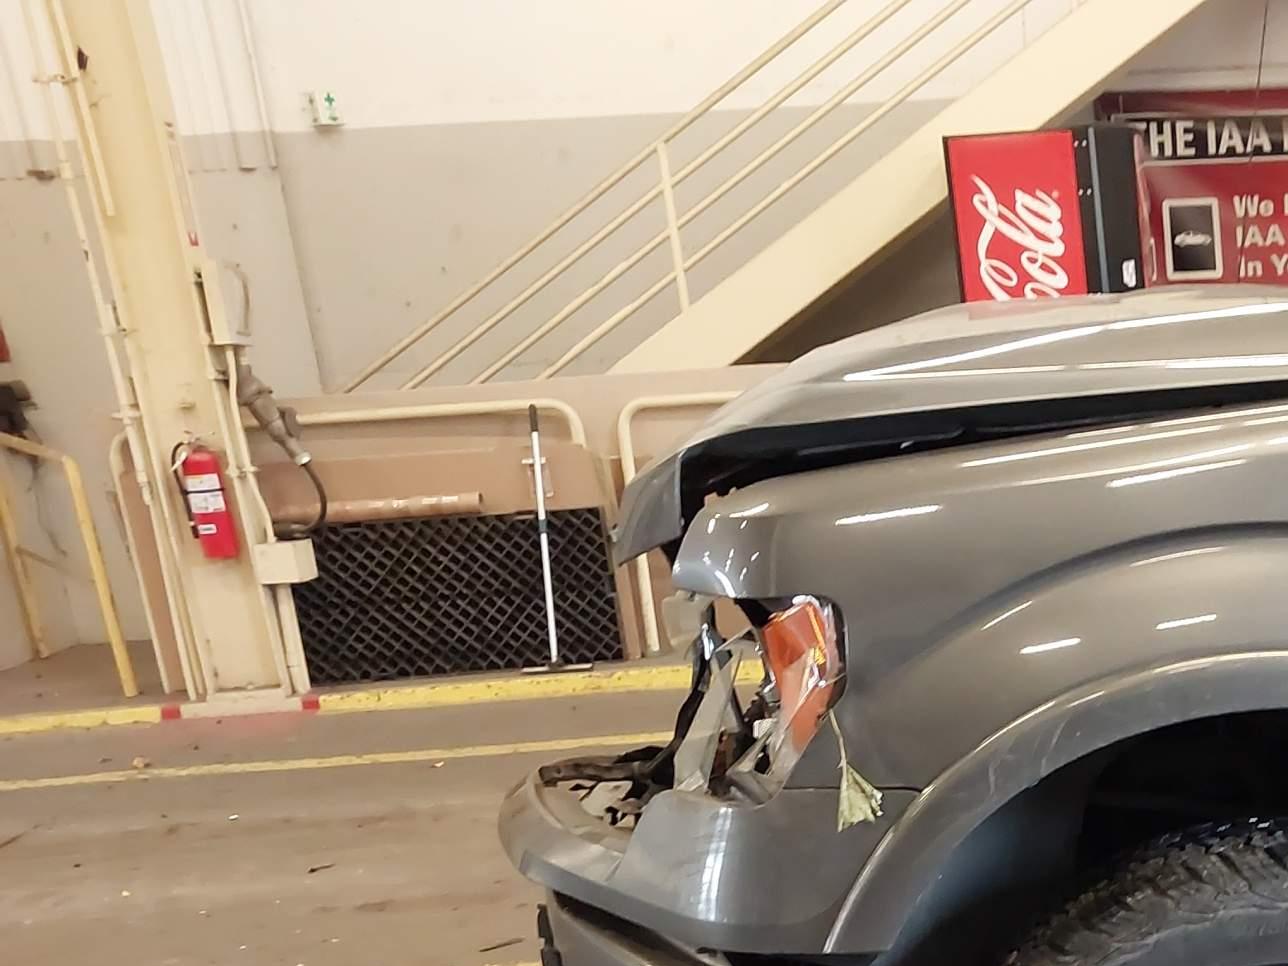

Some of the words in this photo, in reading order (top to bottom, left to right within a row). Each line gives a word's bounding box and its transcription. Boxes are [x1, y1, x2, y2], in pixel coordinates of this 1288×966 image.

[1206, 118, 1273, 156] IAA
[1232, 194, 1275, 219] We
[1235, 223, 1286, 249] IAA
[1238, 255, 1263, 279] In
